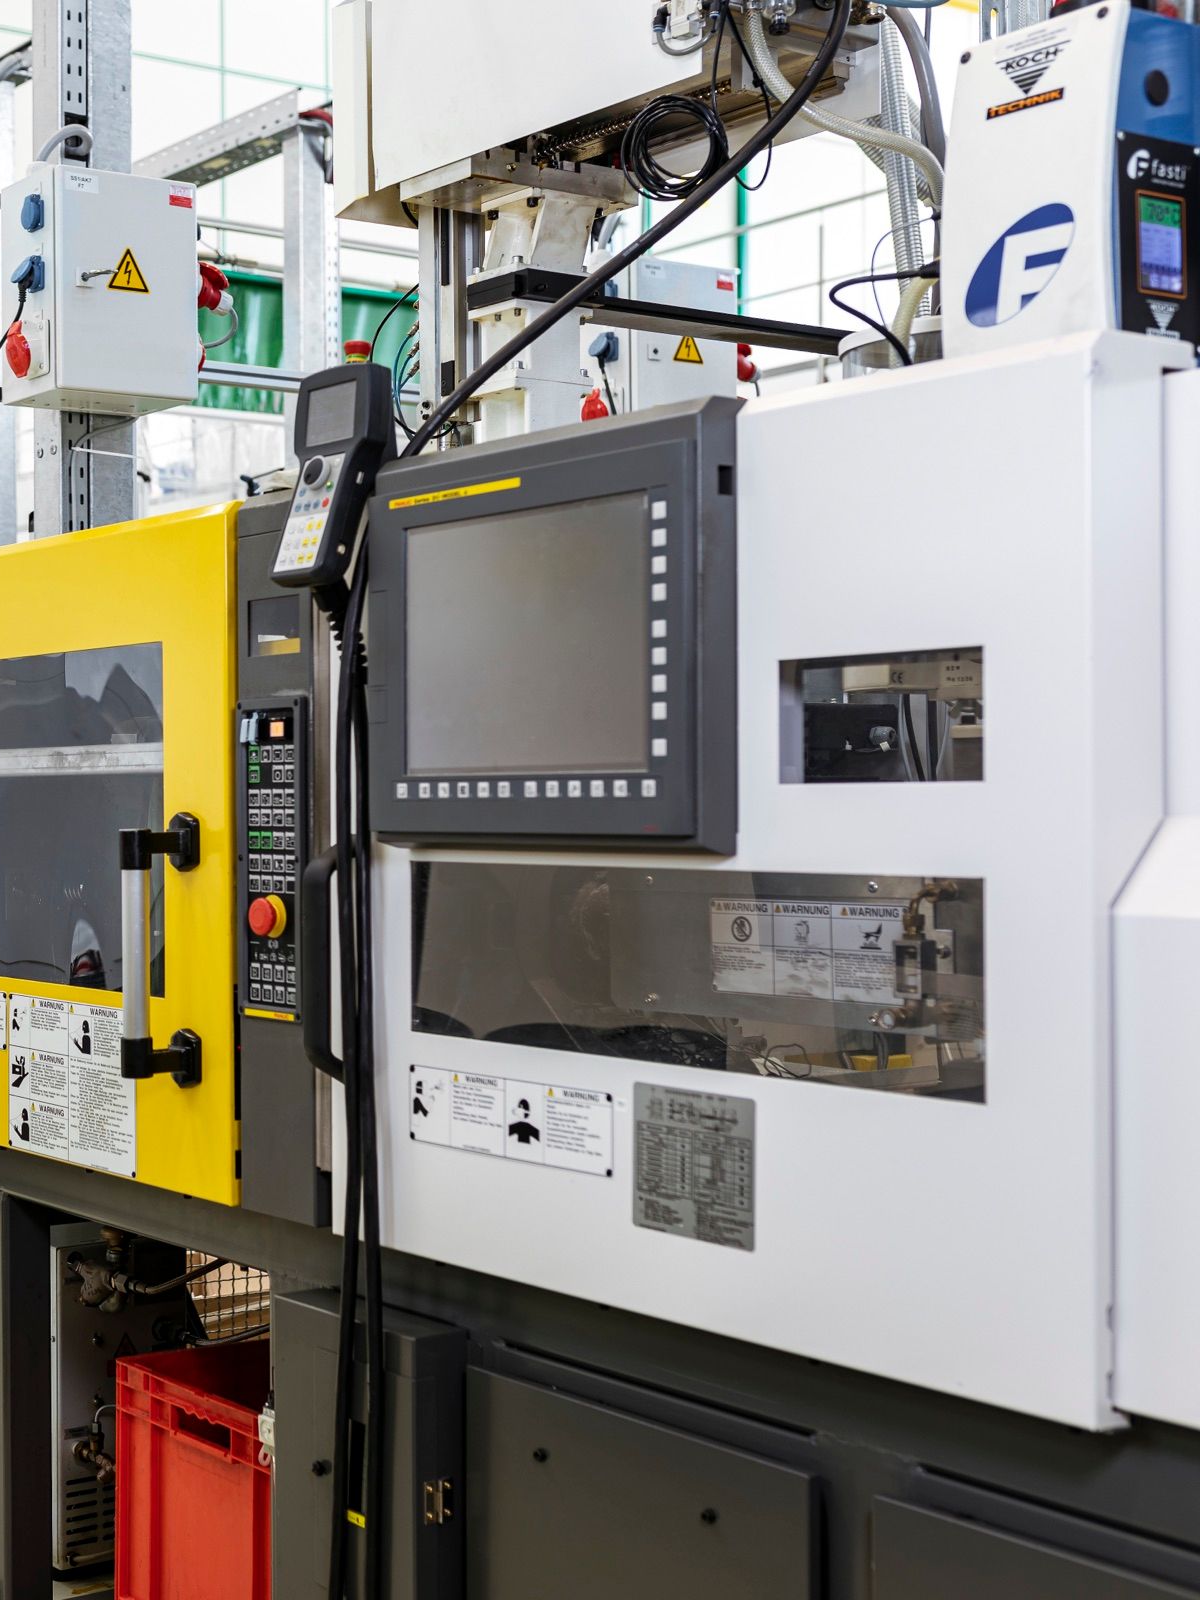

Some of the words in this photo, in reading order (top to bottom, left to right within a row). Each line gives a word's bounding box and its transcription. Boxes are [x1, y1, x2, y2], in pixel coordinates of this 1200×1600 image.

[1005, 47, 1058, 72] KOCH
[988, 89, 1062, 119] TECHNIK
[1151, 158, 1187, 181] fasti
[723, 902, 768, 913] WARNUNG
[782, 904, 829, 916] WARNUNG
[850, 907, 900, 918] WARNUNG
[39, 1000, 65, 1011] WARNUNG
[89, 1007, 118, 1019] WARNUNG
[39, 1054, 65, 1066] WARNUNG
[465, 1075, 498, 1087] WARNUNG
[563, 1090, 600, 1103] WARNUNG
[39, 1104, 65, 1117] WARNUNG
